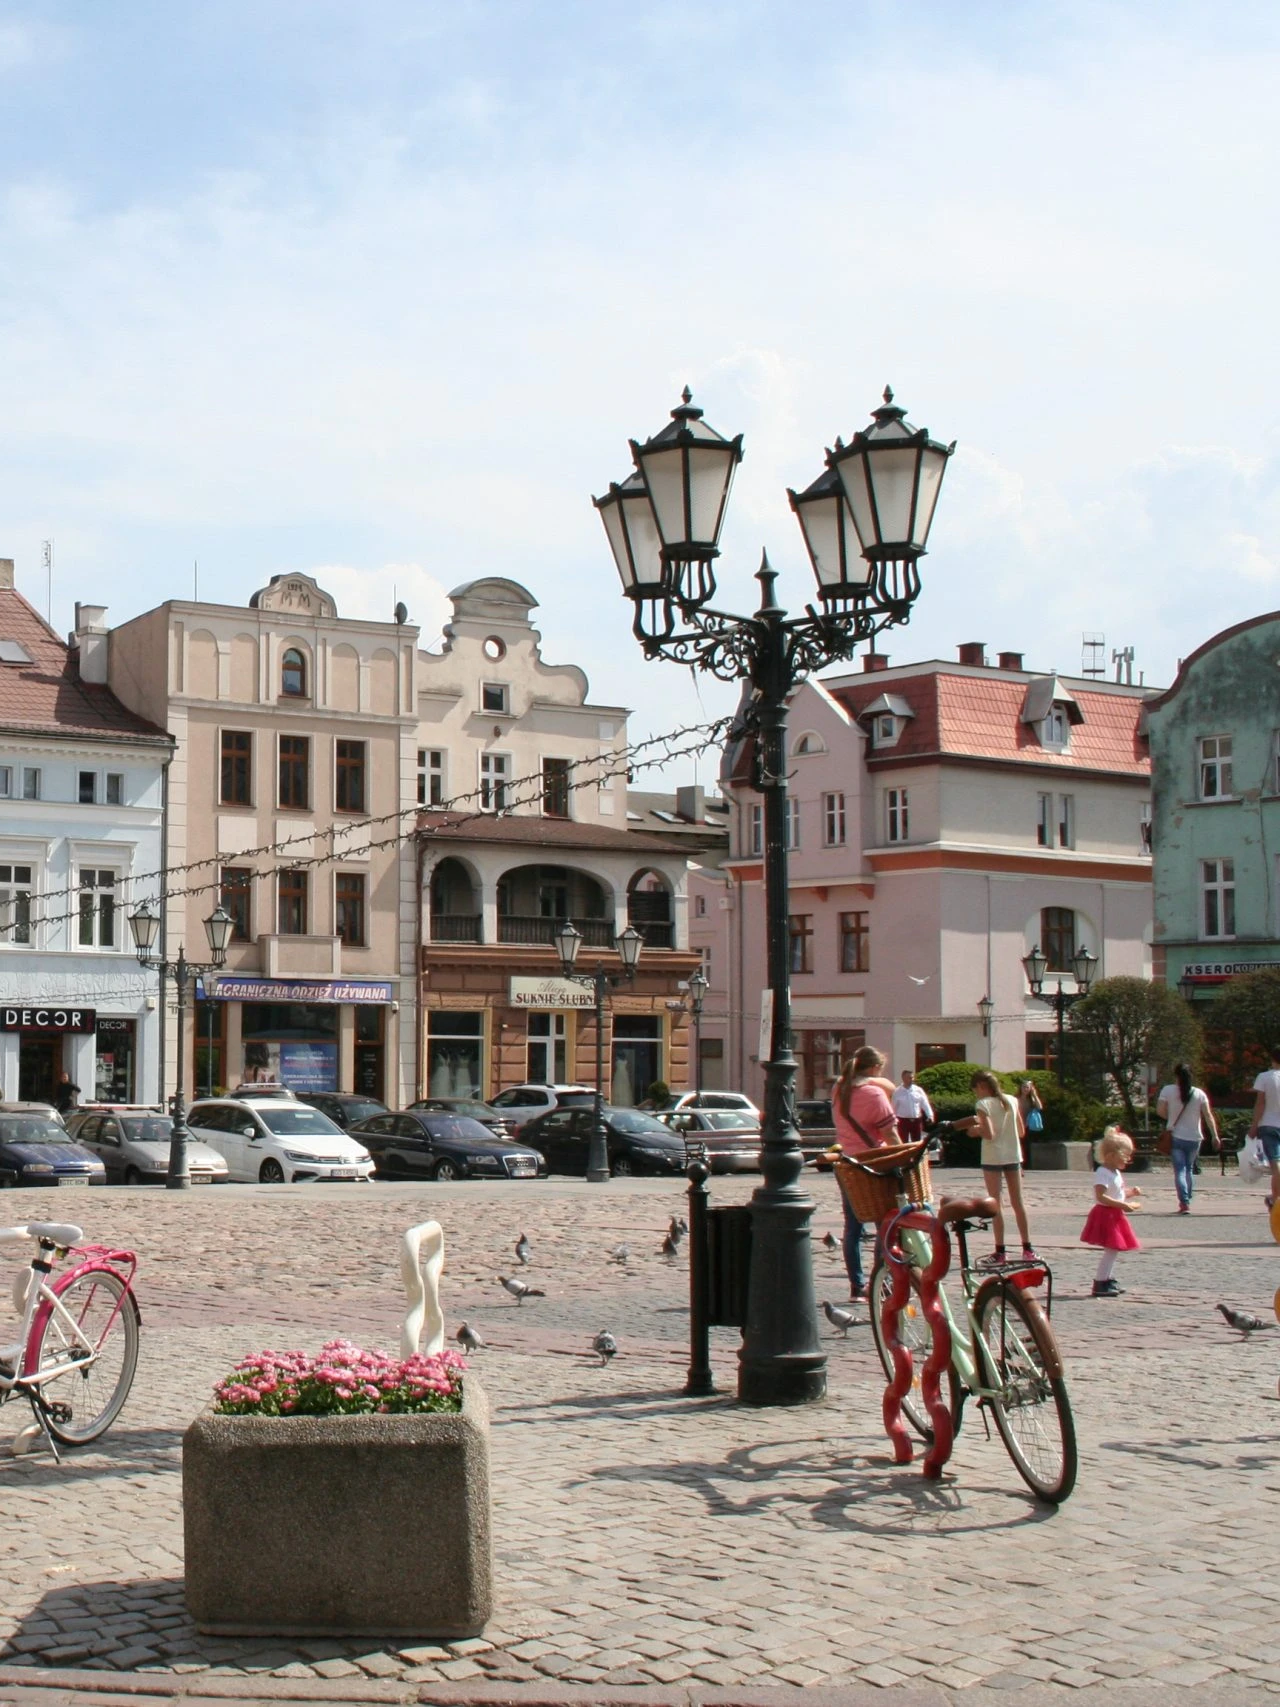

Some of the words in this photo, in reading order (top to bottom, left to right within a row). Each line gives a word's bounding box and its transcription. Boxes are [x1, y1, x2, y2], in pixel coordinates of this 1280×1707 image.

[214, 983, 289, 998] AGRANICZNA
[333, 984, 387, 1000] UŻYWANA
[516, 992, 555, 1004] SUKNIE
